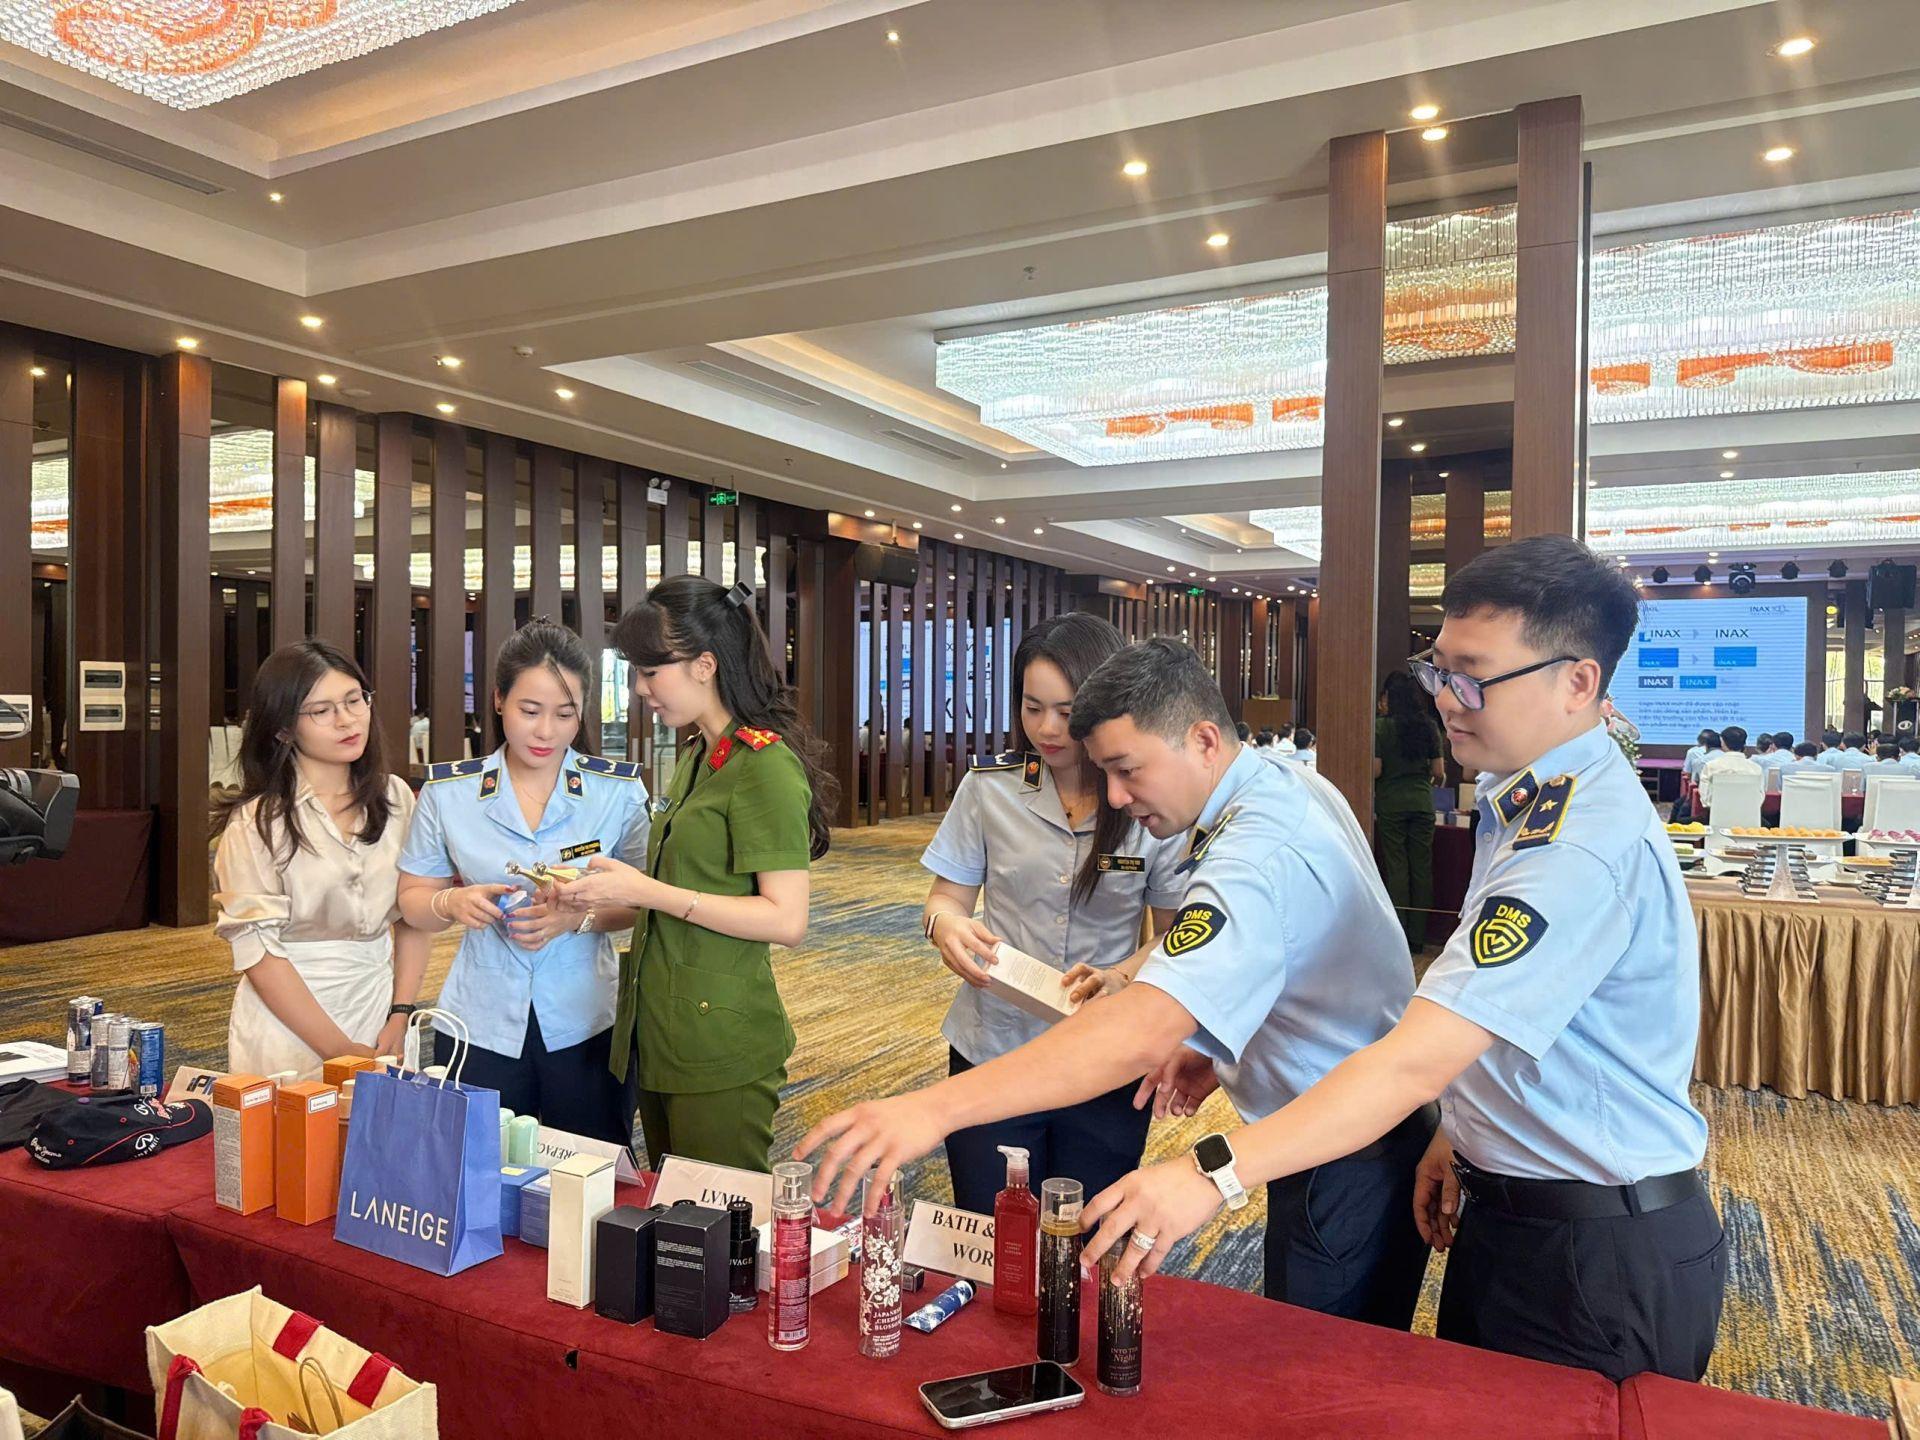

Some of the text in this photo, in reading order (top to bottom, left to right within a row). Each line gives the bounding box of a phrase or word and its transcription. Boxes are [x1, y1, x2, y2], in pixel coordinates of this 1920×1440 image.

[1650, 629, 1681, 638] INAX
[1715, 628, 1749, 639] INAX
[1643, 678, 1669, 686] INAX
[1183, 909, 1213, 921] DMS
[1495, 904, 1532, 929] DMS
[350, 1191, 449, 1247] LANEIGE
[932, 1210, 995, 1239] BATH &
[953, 1243, 995, 1268] WOR
[1114, 1353, 1136, 1364] Night
